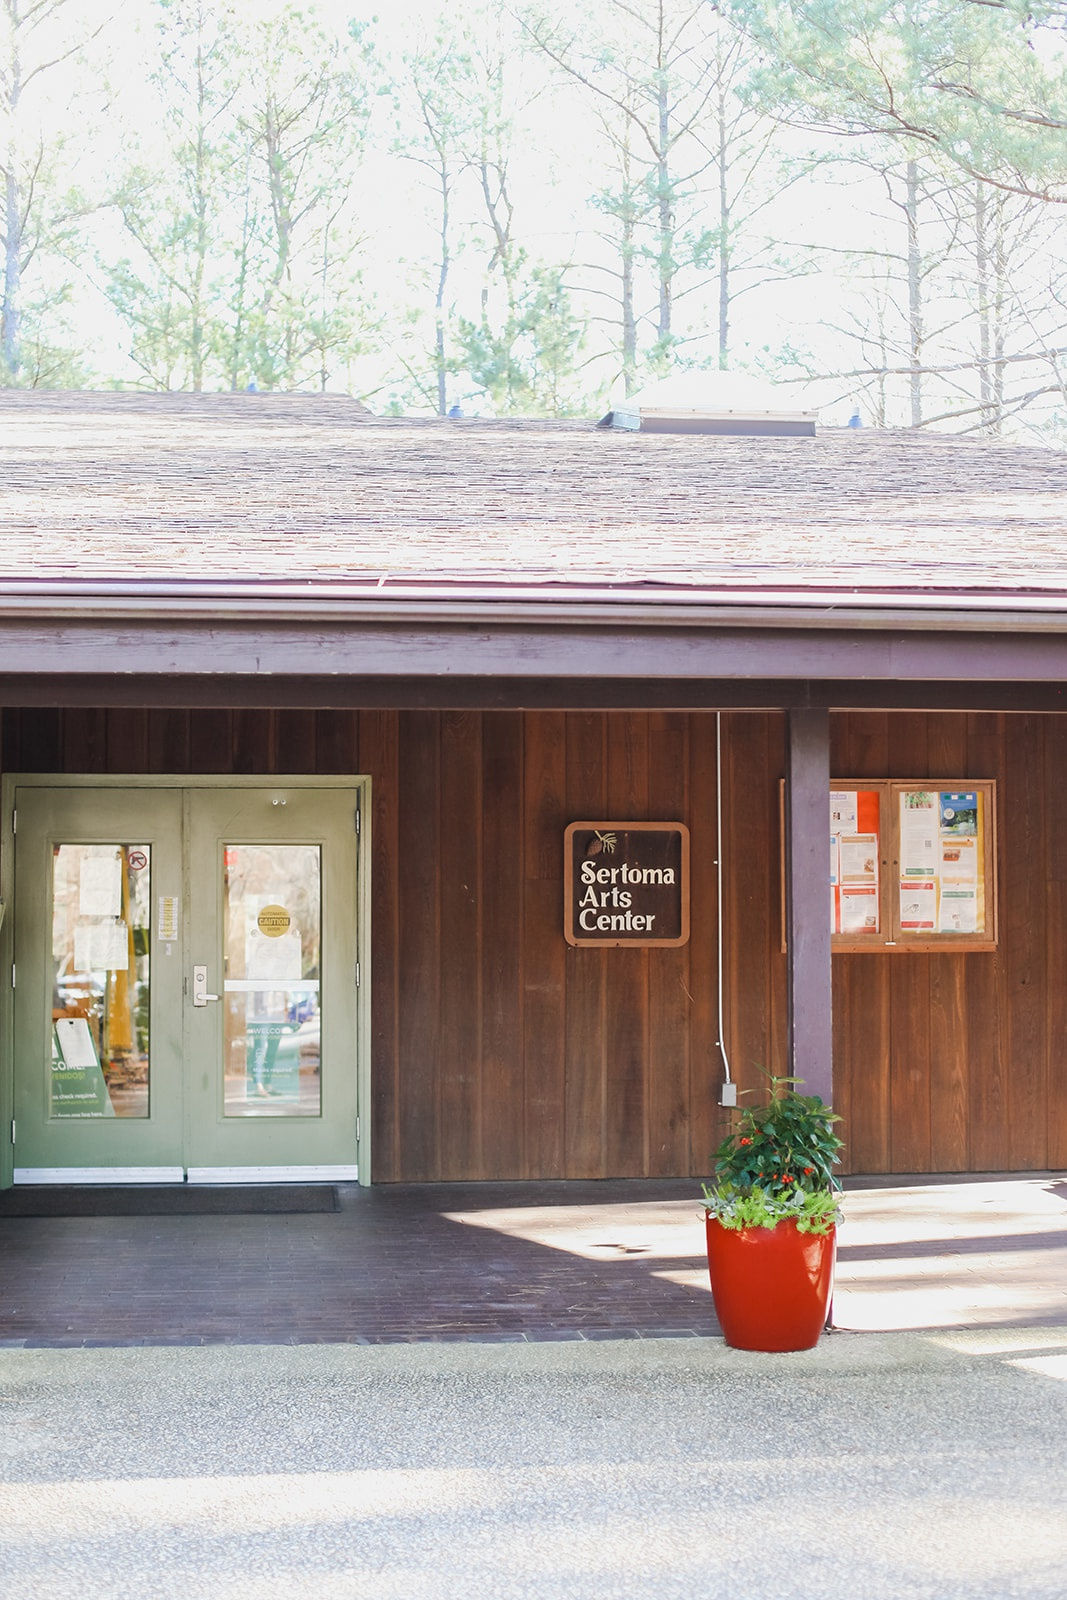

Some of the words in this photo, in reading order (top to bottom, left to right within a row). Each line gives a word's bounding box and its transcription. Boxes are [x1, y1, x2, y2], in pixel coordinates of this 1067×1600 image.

[580, 860, 675, 884] Sertoma
[578, 885, 633, 908] Arts
[579, 908, 656, 931] Center
